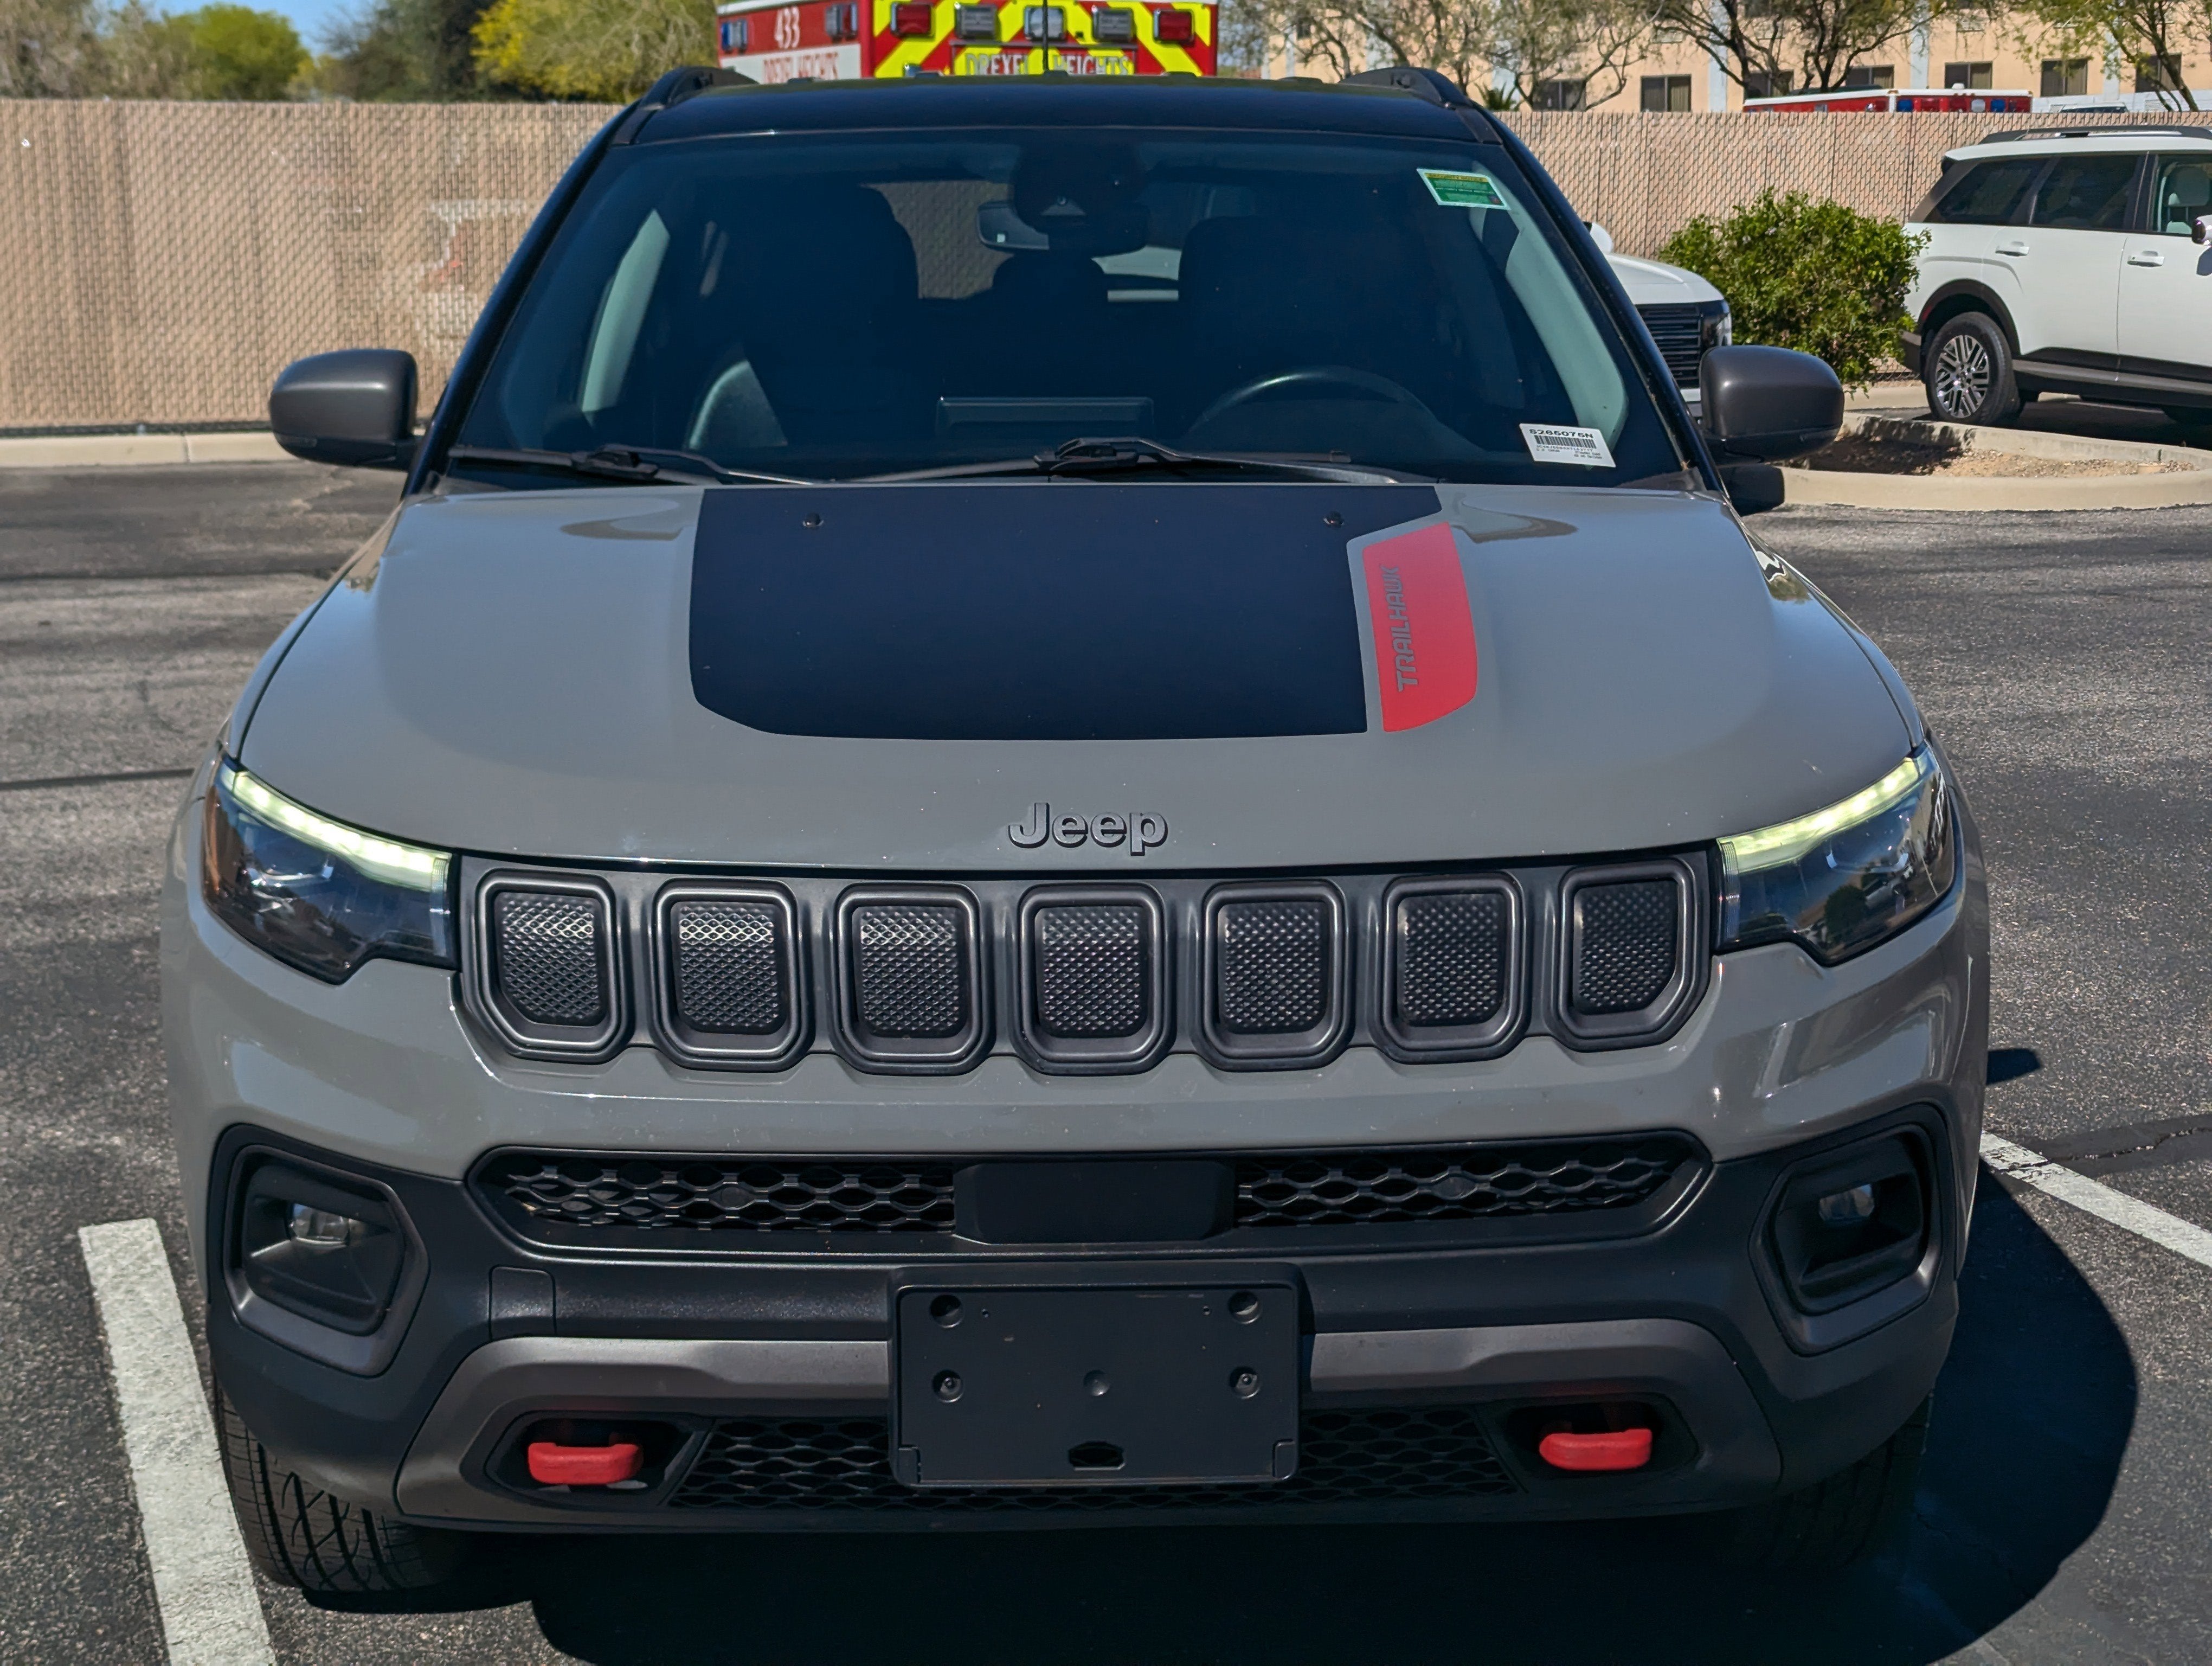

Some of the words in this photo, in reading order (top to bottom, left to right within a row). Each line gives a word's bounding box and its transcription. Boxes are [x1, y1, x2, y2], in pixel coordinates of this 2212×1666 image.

[774, 7, 800, 49] 433
[1053, 54, 1133, 75] HEIGHTS
[1380, 564, 1419, 692] TRAILHAWK
[1008, 802, 1168, 856] Jeep
